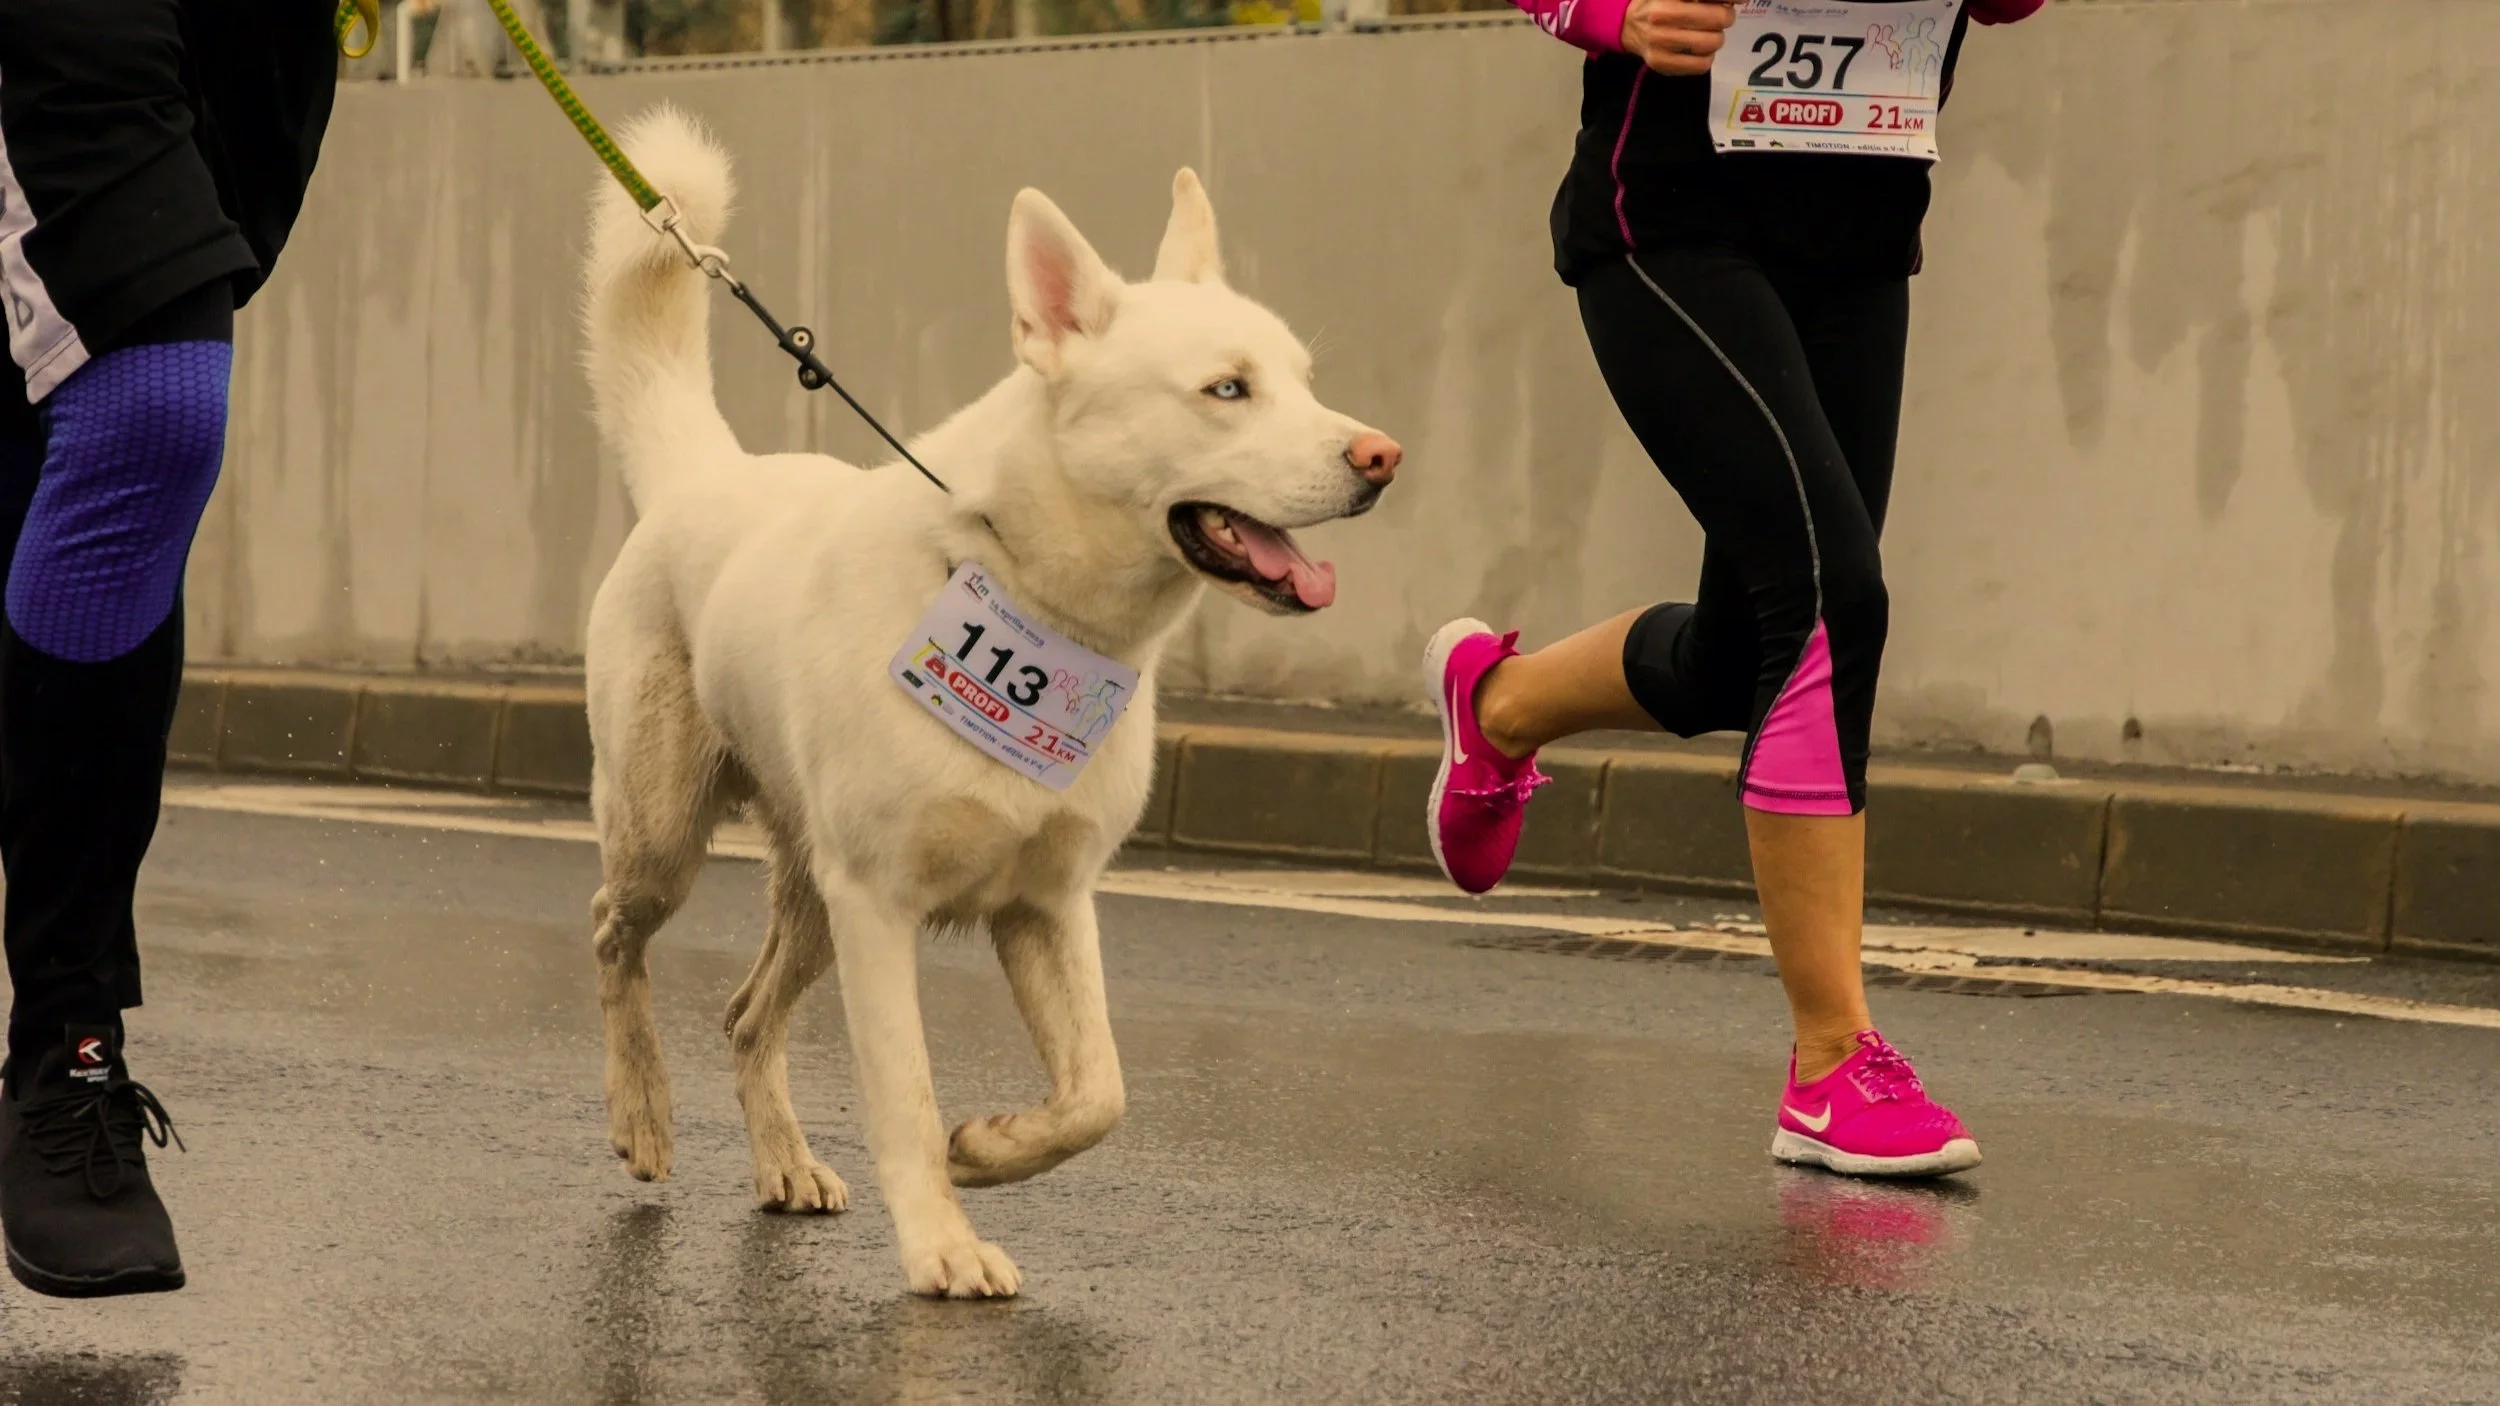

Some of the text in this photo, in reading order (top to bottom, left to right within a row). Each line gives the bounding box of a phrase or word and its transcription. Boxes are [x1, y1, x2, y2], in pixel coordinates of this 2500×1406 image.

[1748, 32, 1865, 90] 257
[1775, 103, 1836, 124] PROFI
[1805, 141, 1850, 150] TIMOTION
[956, 621, 1049, 707] 113
[951, 674, 1006, 720] PROFI
[960, 715, 998, 744] TIMOTION
